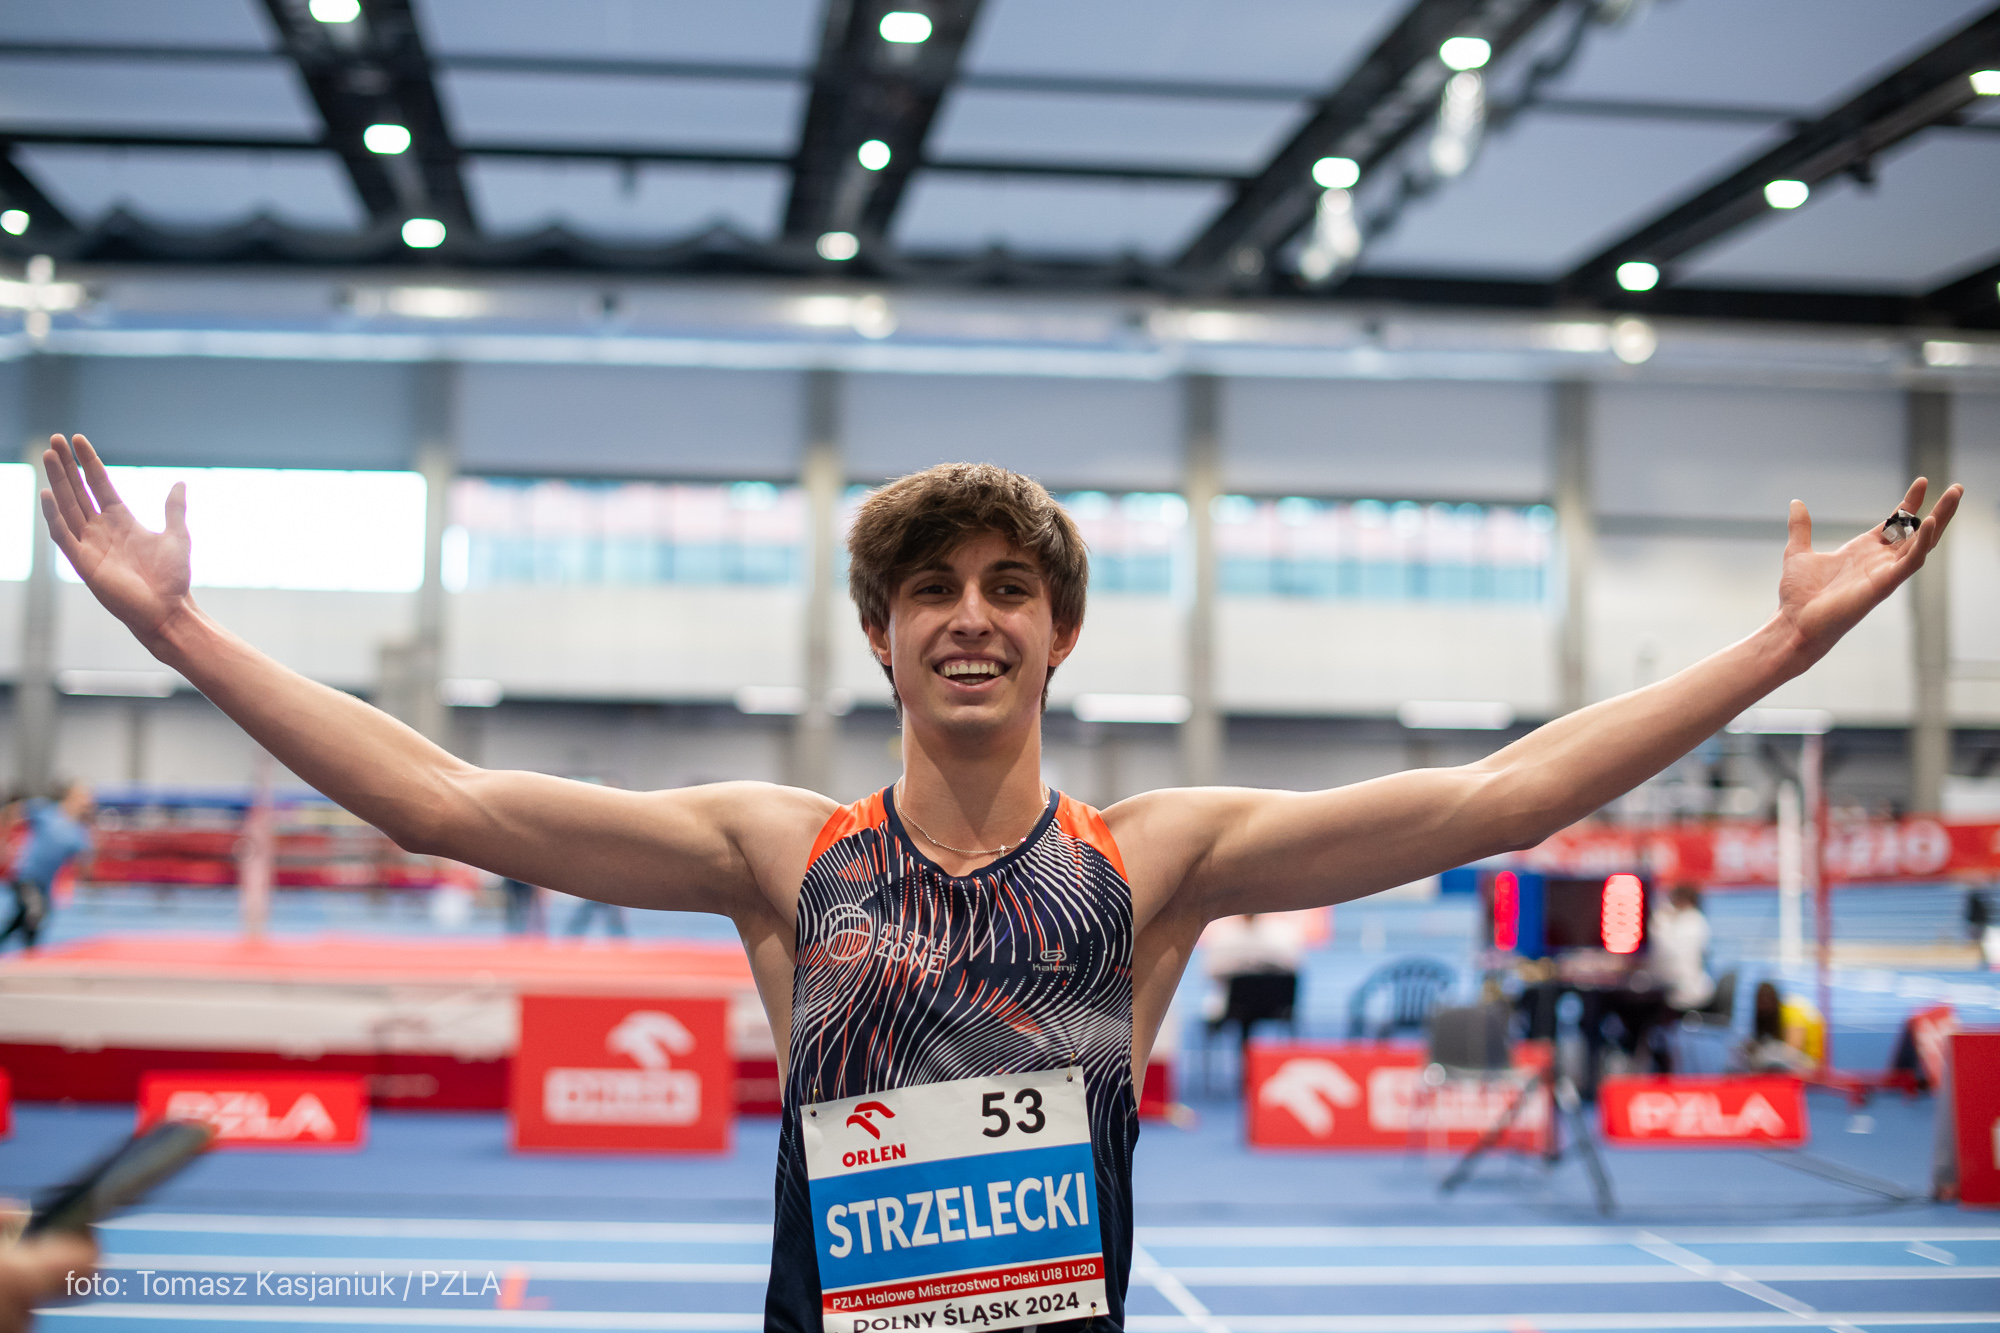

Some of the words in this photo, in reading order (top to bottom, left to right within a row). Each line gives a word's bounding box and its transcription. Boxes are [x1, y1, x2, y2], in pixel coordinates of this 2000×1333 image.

[874, 936, 946, 974] ZONE
[881, 923, 901, 939] FIT
[905, 931, 949, 954] STYLE
[1032, 963, 1076, 974] Kalenji
[981, 1087, 1046, 1138] 53
[842, 1143, 907, 1168] ORLEN
[826, 1171, 1090, 1259] STRZELECKI
[832, 1295, 864, 1309] PZLA
[866, 1290, 915, 1305] Halowe
[918, 1277, 1000, 1298] Mistrzostwa
[1003, 1270, 1039, 1286] Polski
[1041, 1267, 1063, 1281] U18
[1065, 1266, 1069, 1278] i
[1071, 1263, 1096, 1277] U20
[853, 1310, 937, 1333] DOLNY
[943, 1302, 1021, 1326] ŚLĄSK
[1025, 1291, 1080, 1315] 2024
